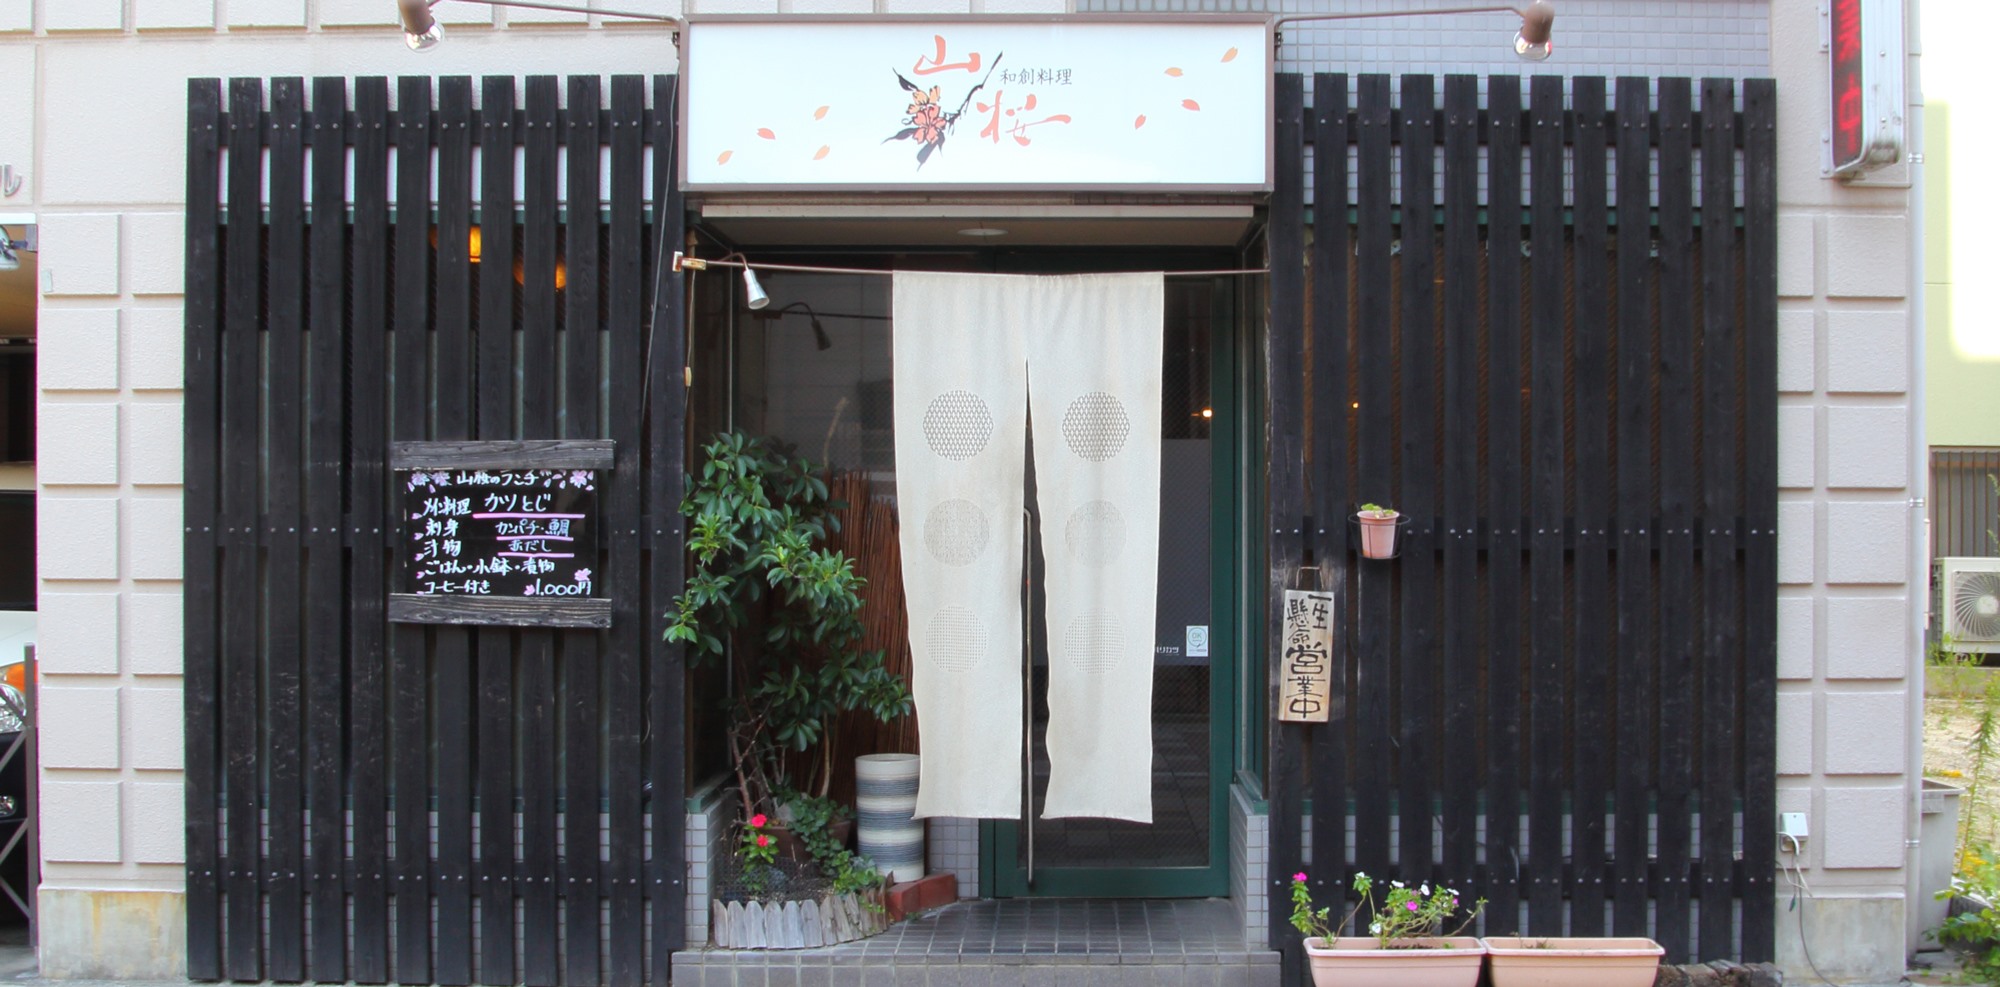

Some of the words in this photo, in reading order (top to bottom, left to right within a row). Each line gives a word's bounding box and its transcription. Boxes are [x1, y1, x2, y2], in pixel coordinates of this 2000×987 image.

[1000, 67, 1072, 86] 和創料理
[484, 492, 551, 513] カツとじ
[425, 518, 459, 538] 刺身
[423, 539, 462, 558] 汁物
[508, 539, 552, 552] 赤だし
[1285, 641, 1328, 719] 営業中
